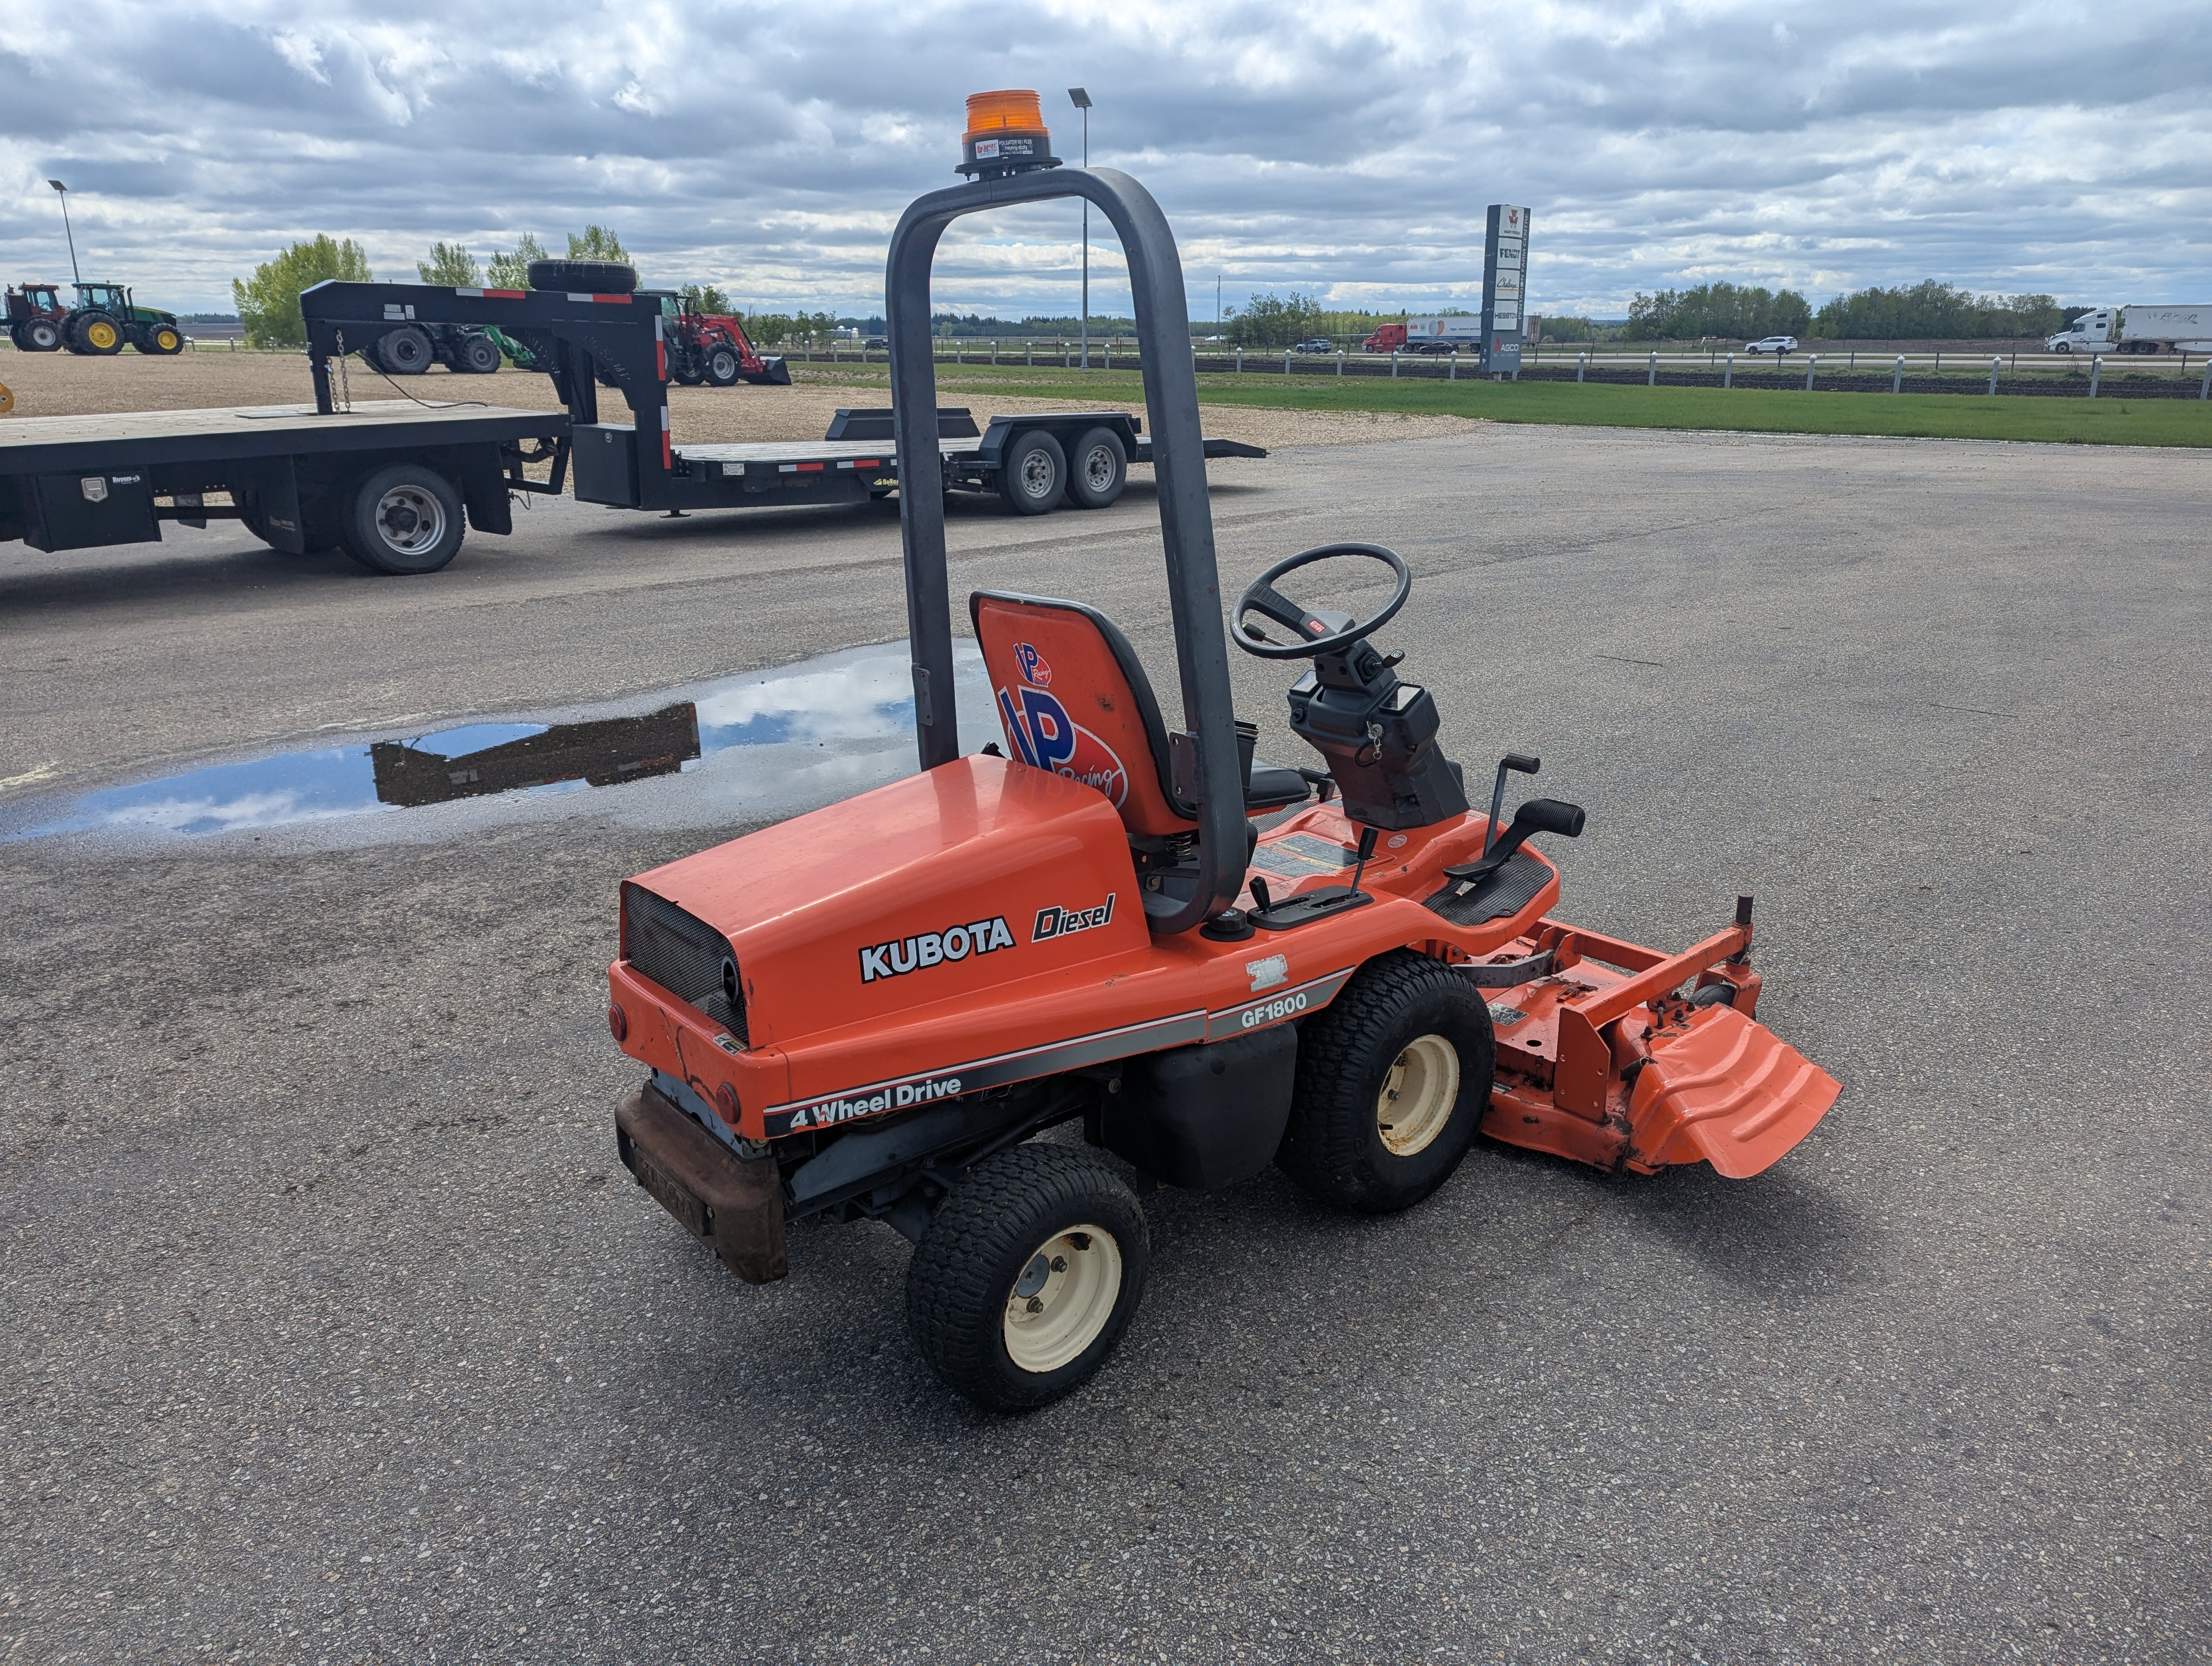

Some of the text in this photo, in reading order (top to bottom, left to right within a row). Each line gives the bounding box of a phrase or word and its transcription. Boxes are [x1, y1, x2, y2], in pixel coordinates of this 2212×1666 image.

[1500, 248, 1521, 259] FENDT
[1013, 643, 1038, 684] VP
[1033, 669, 1050, 680] Racing
[1032, 893, 1116, 943] Diesel
[860, 917, 1015, 983] KUBOTA
[1242, 993, 1307, 1028] GF1800
[790, 1078, 961, 1128] 4 Wheel Drive
